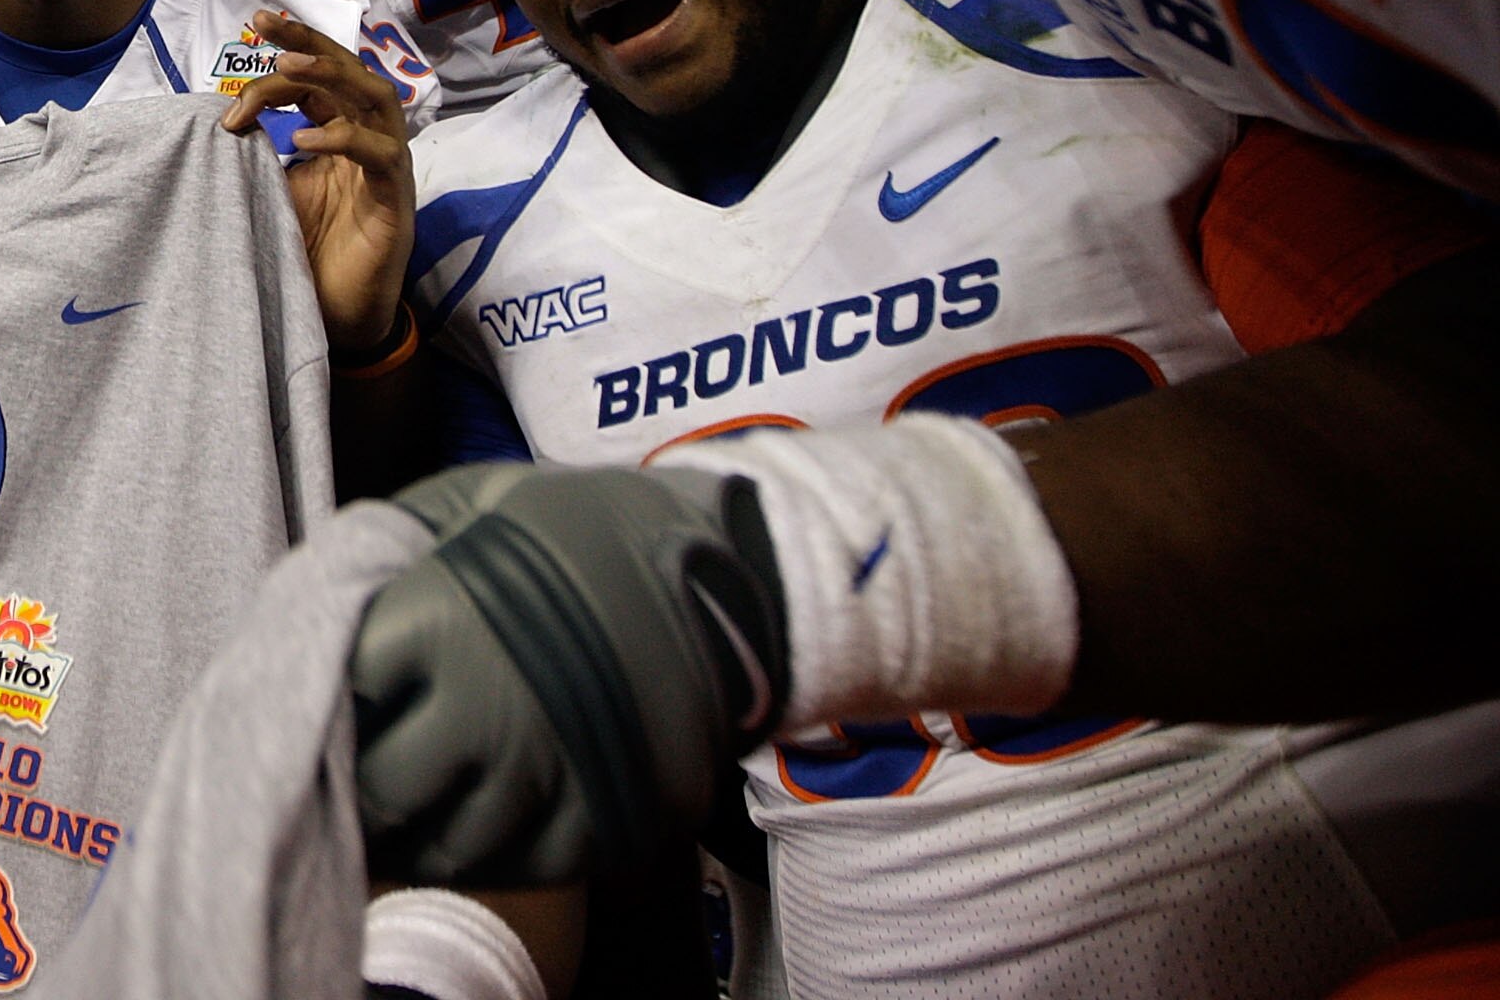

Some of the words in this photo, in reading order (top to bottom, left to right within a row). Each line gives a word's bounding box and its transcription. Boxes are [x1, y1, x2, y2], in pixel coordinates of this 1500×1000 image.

[479, 275, 608, 347] WAC
[594, 258, 1001, 429] BRONCOS
[0, 690, 43, 719] BOWL
